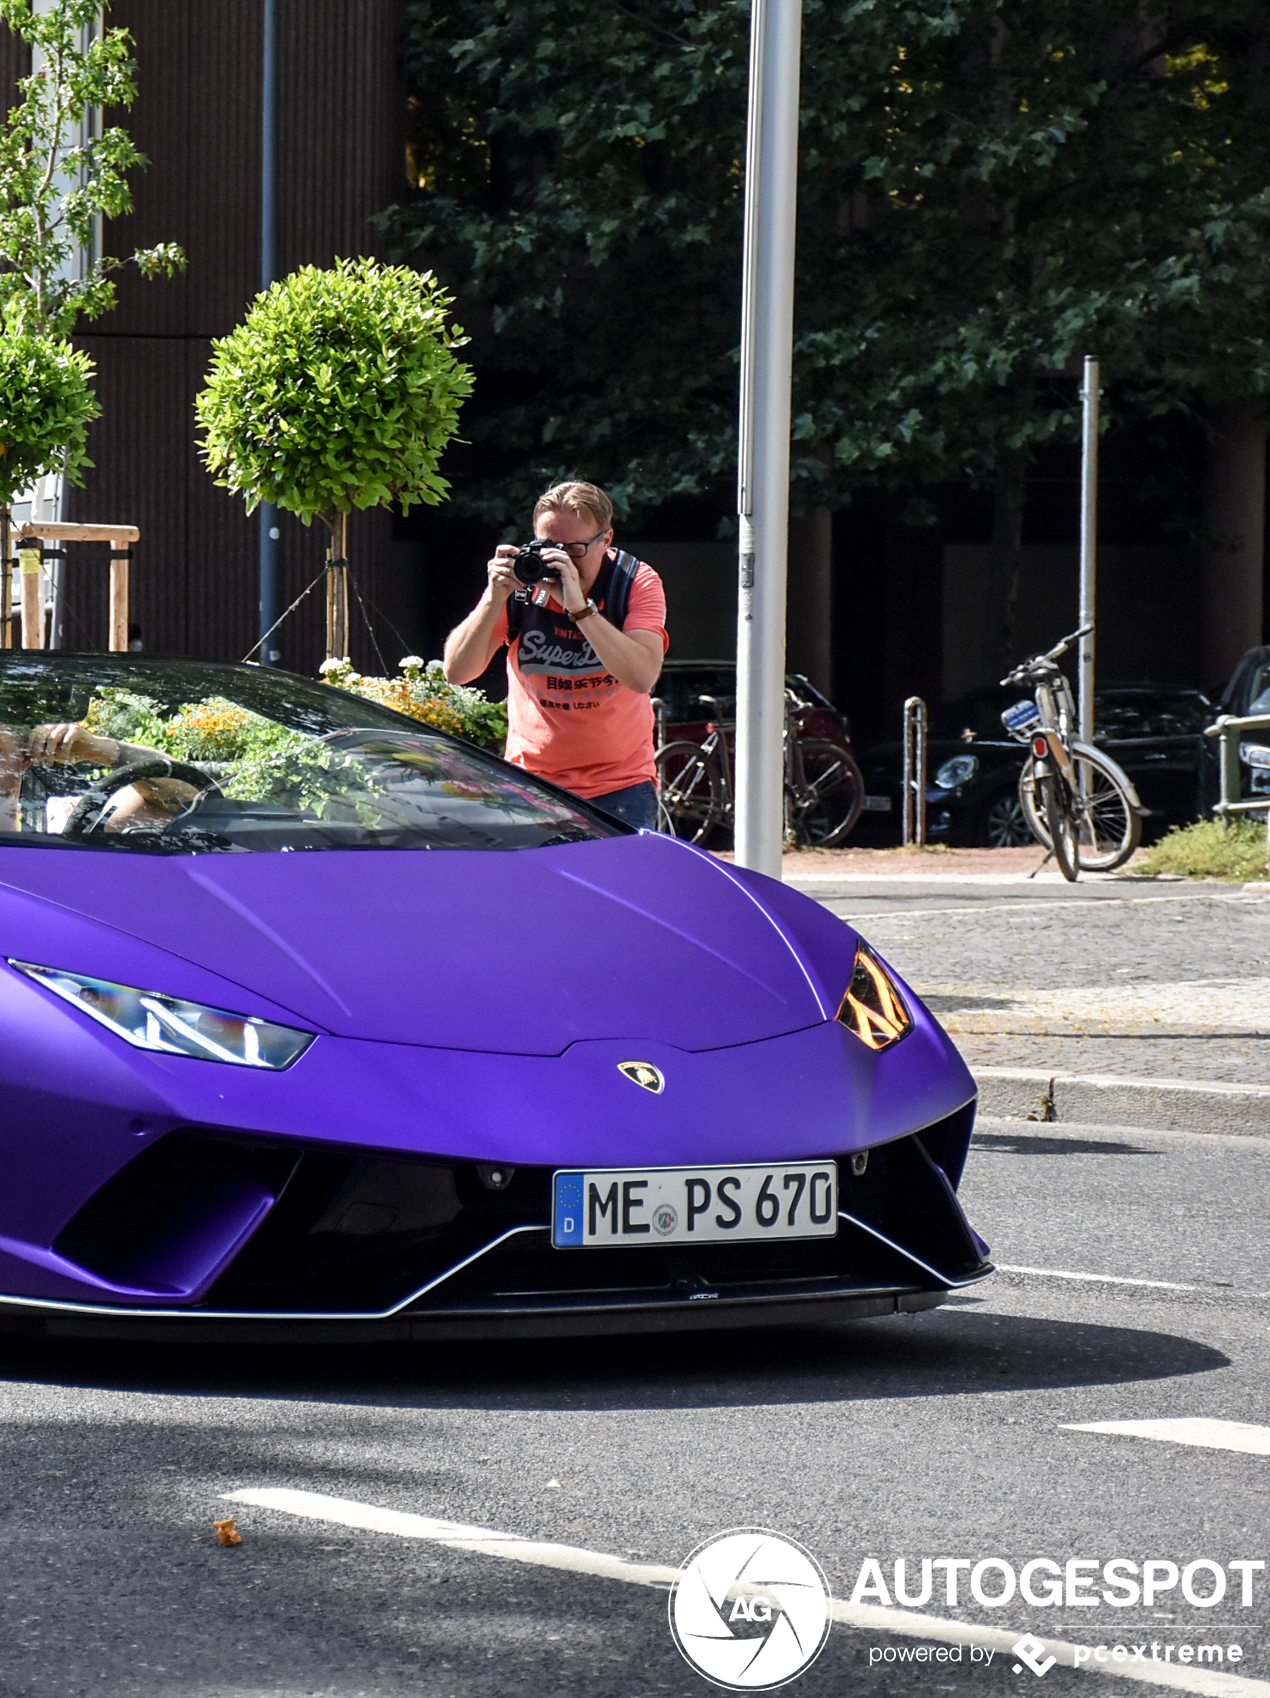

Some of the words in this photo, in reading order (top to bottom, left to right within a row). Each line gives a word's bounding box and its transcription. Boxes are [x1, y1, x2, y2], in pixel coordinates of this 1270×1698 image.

[555, 626, 587, 639] VINTAG
[518, 630, 604, 667] SuperD
[588, 1180, 650, 1235] ME
[685, 1176, 742, 1231] PS
[755, 1172, 831, 1227] 670
[563, 1217, 574, 1233] D
